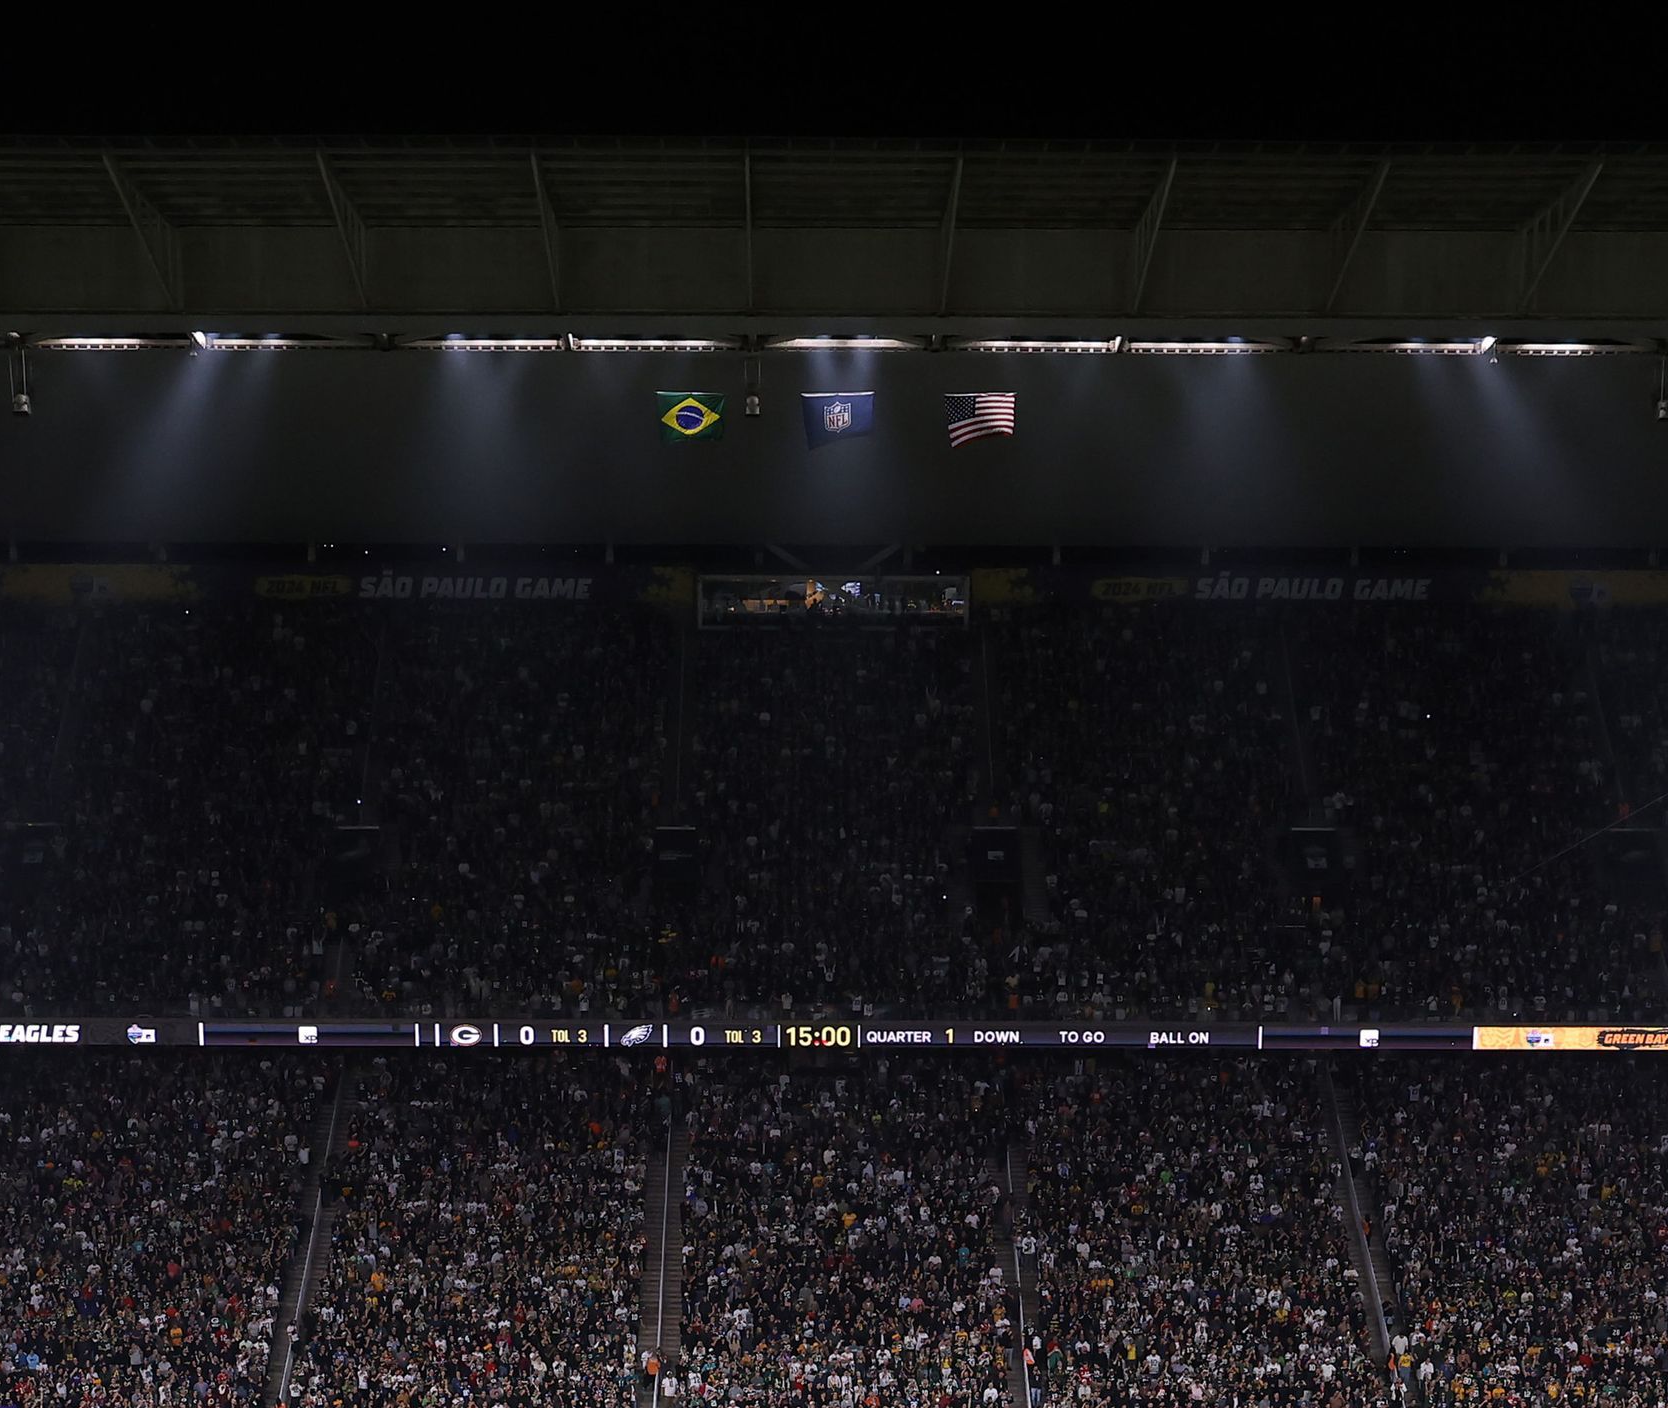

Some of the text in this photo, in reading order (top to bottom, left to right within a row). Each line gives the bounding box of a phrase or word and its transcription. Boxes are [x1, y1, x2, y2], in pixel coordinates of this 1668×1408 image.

[827, 412, 848, 429] NFL
[358, 570, 408, 598] SÃO
[420, 576, 508, 599] PAULO
[515, 577, 592, 599] GAME
[1194, 571, 1246, 599] SÃO
[1255, 577, 1343, 600] PAULO
[1352, 577, 1433, 600] GAME
[519, 1026, 588, 1045] 0 TOL 3
[690, 1026, 762, 1046] 0 TOL 3
[785, 1026, 852, 1047] 15:00
[866, 1029, 954, 1044] QUARTER 1
[974, 1030, 1020, 1044] DOWN
[1059, 1030, 1105, 1044] TO GO
[1149, 1030, 1210, 1044] BALL ON
[1604, 1031, 1641, 1045] GREEN
